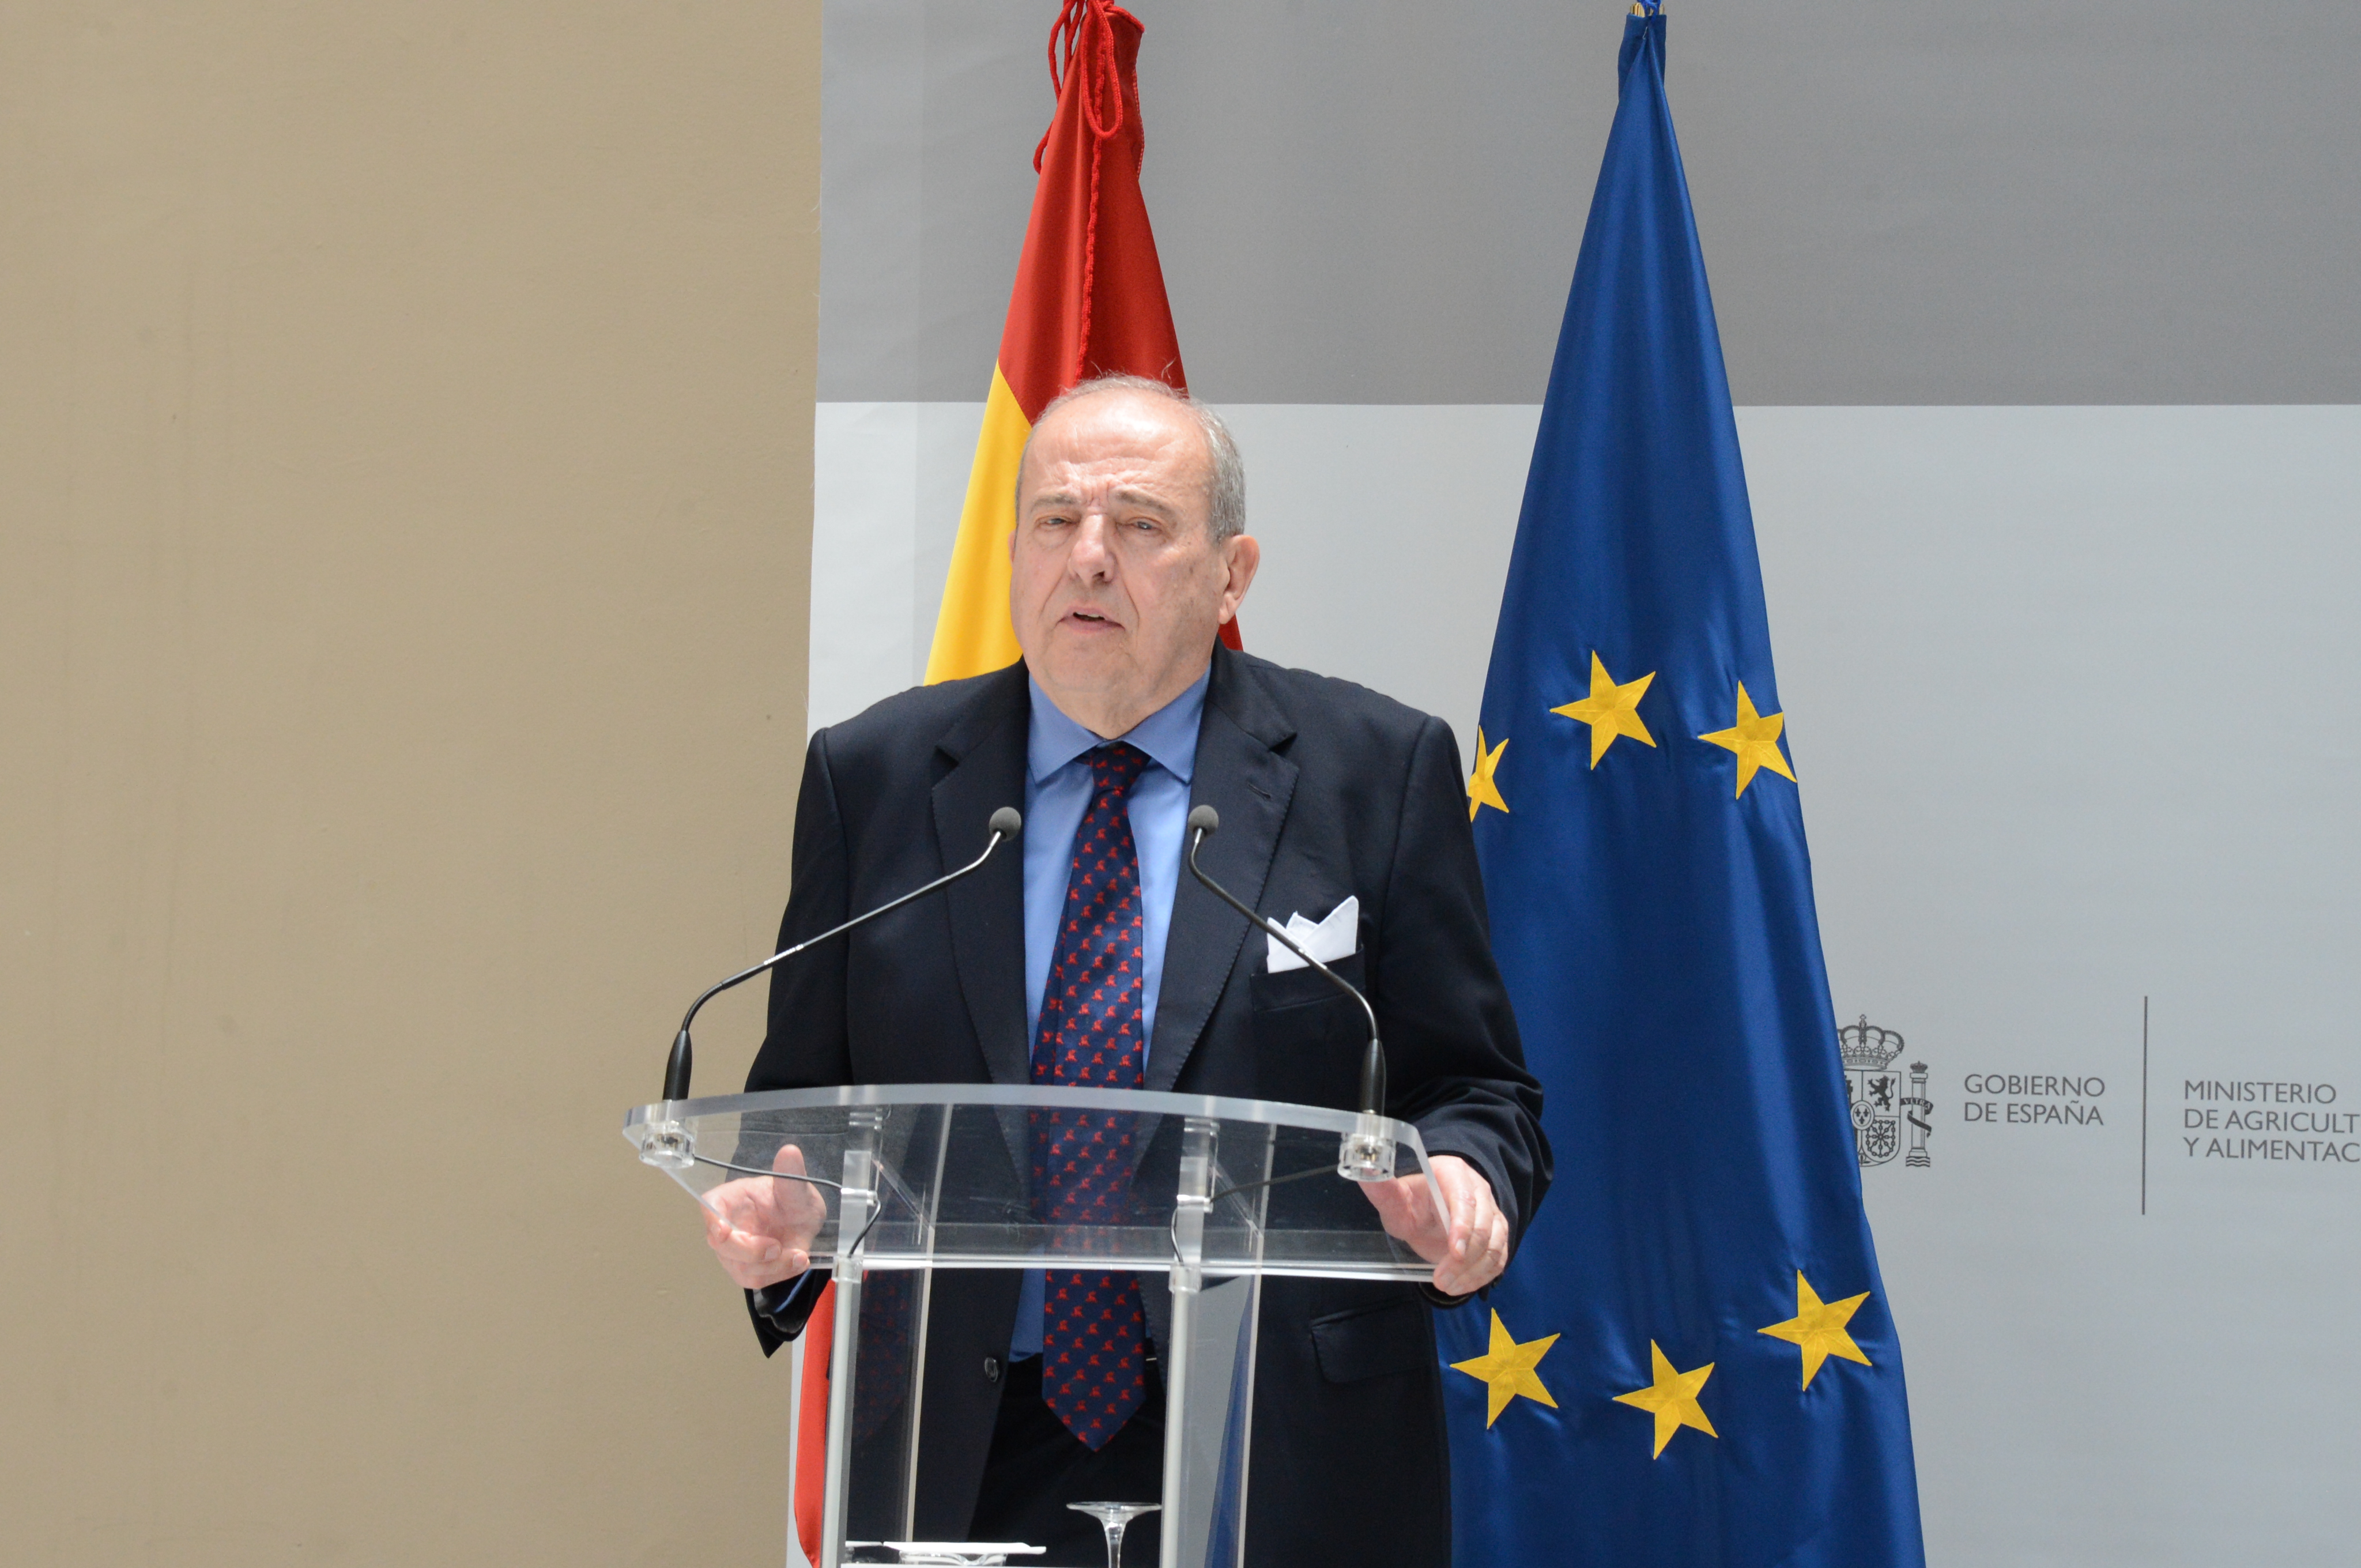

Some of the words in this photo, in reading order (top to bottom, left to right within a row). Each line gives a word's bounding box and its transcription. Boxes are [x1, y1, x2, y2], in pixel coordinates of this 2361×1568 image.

[1964, 1073, 2106, 1098] GOBIERNO
[2185, 1080, 2337, 1105] MINISTERIO
[1964, 1102, 1997, 1122] DE
[2007, 1099, 2104, 1126] ESPAÑA
[2184, 1108, 2219, 1129] DE
[2224, 1110, 2361, 1134] AGRICULT
[2183, 1137, 2200, 1157] Y
[2205, 1137, 2361, 1163] ALIMENTAC
